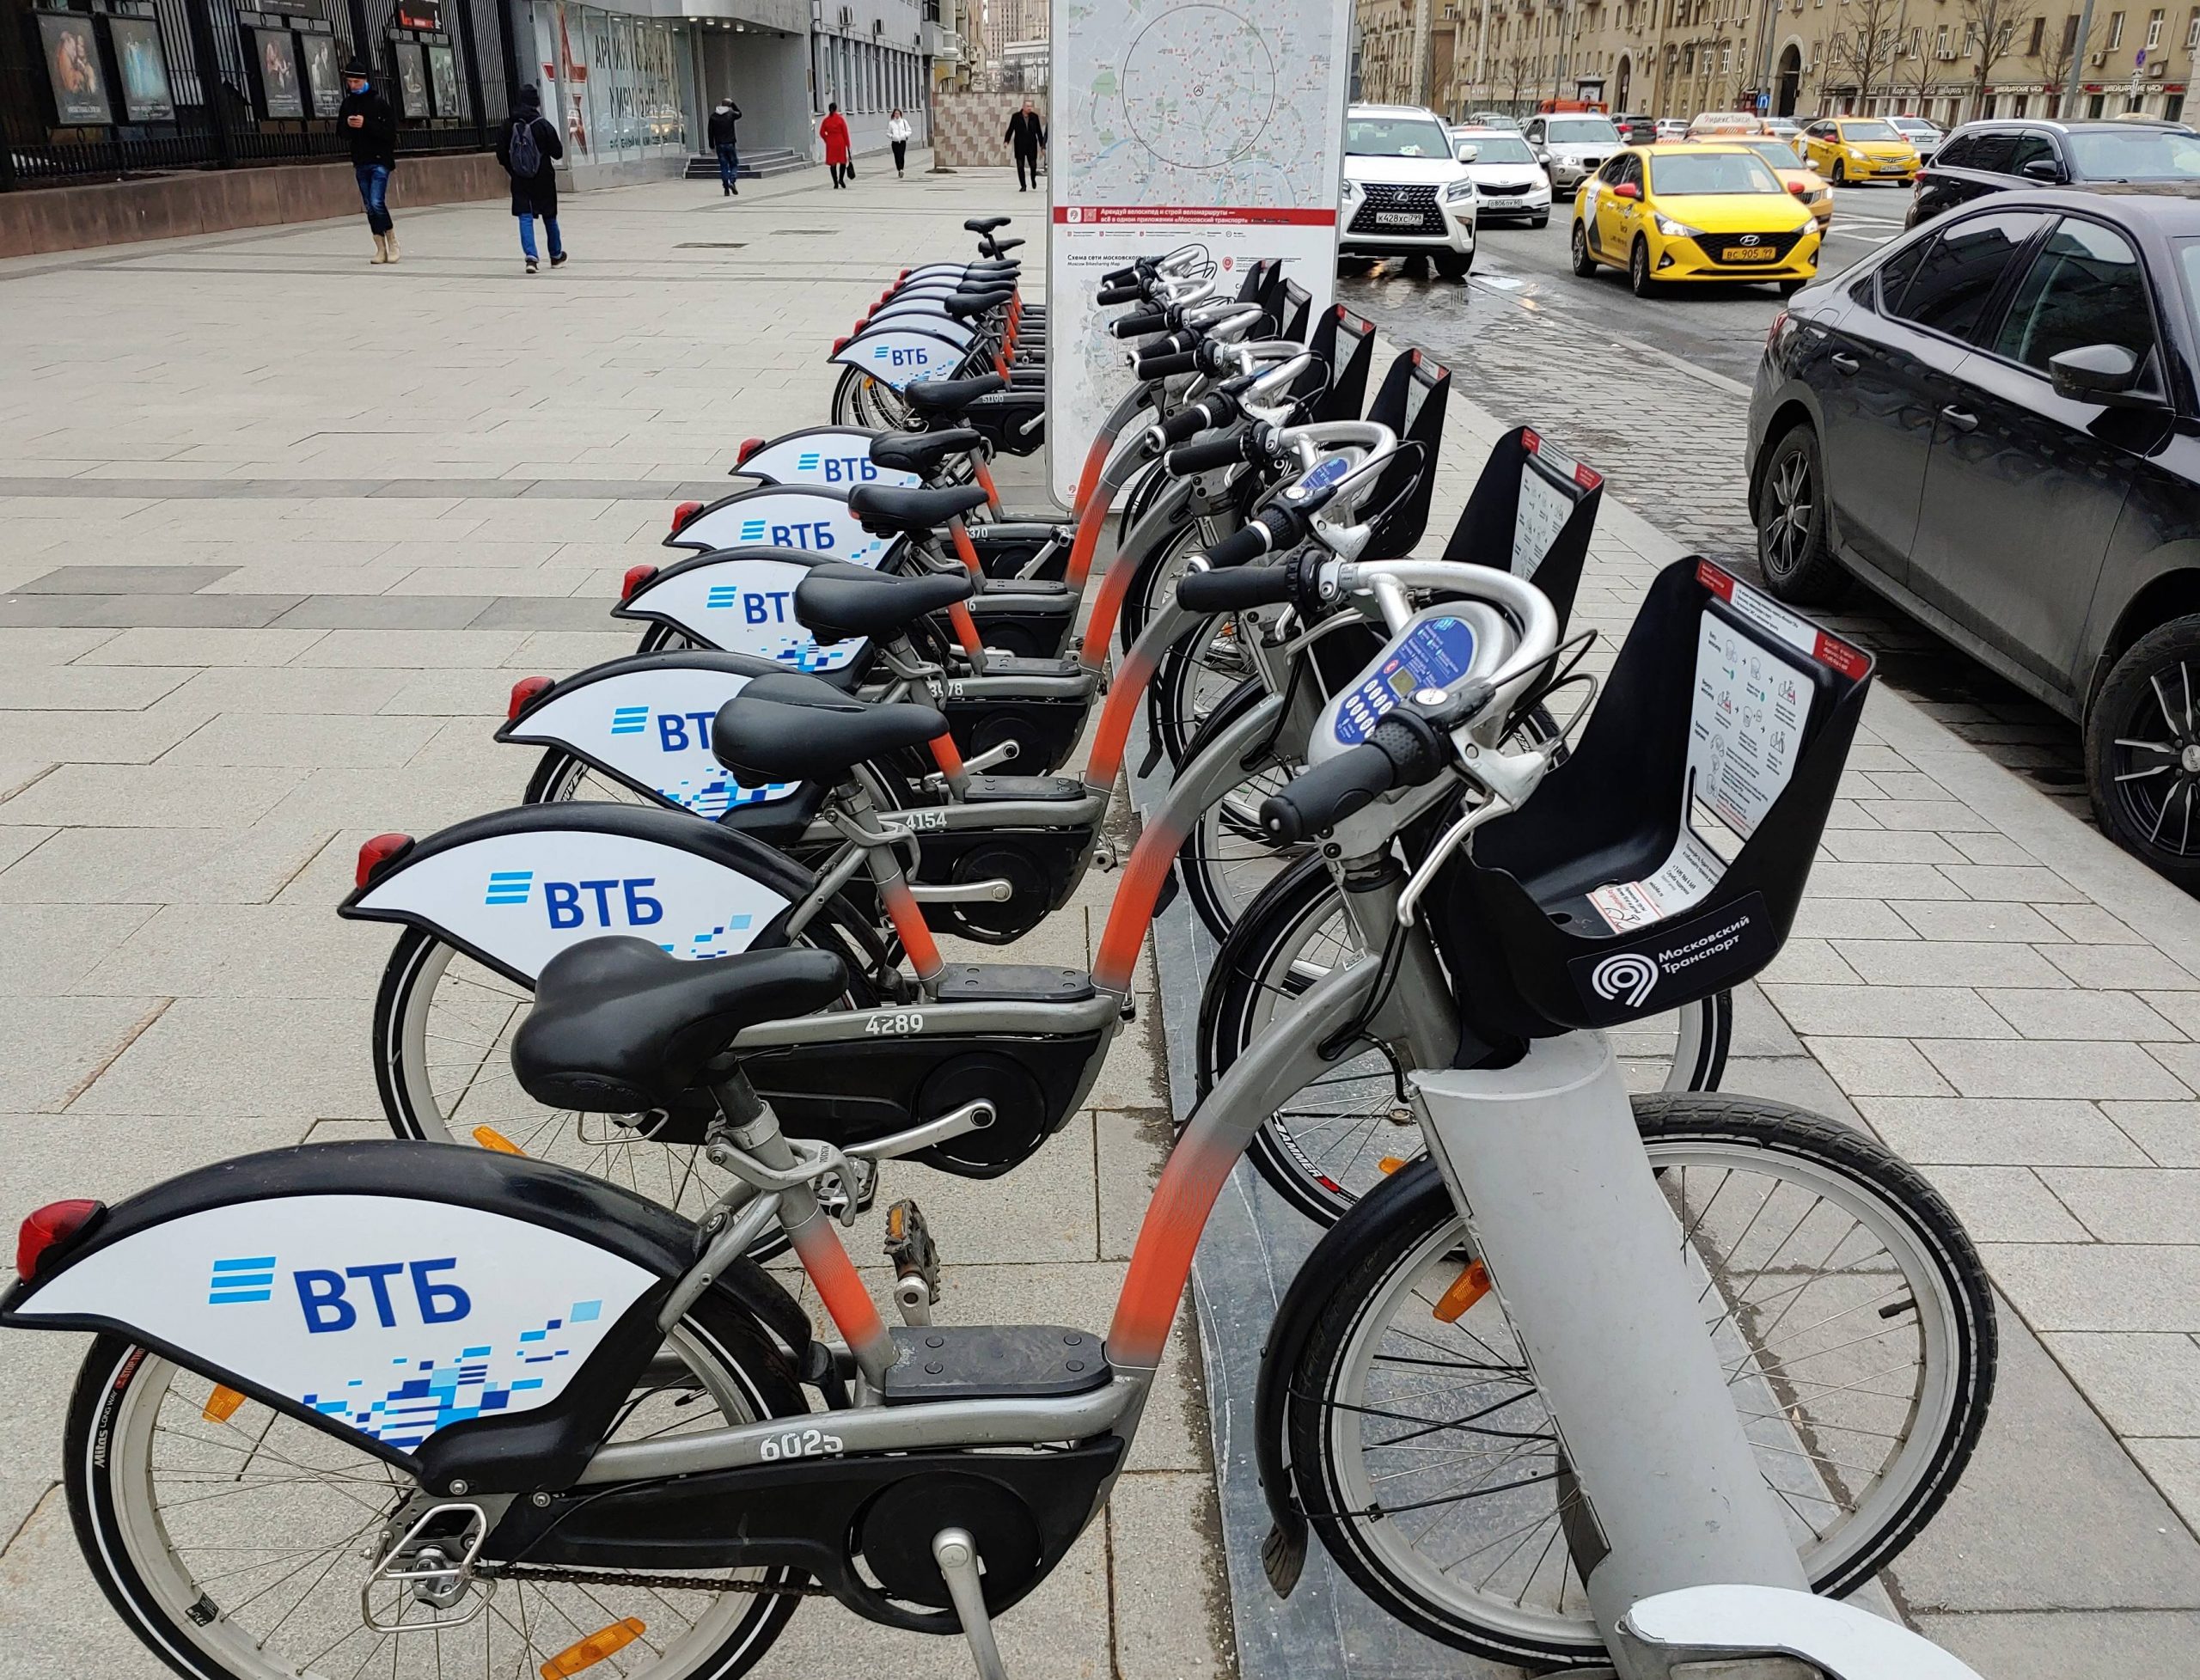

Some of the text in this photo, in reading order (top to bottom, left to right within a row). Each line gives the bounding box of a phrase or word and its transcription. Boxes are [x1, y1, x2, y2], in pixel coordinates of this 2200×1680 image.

[1742, 249, 1759, 259] 905
[891, 348, 928, 366] ВТБ
[824, 457, 878, 483] ВТБ
[772, 522, 835, 550] ВТБ
[965, 527, 988, 539] 370
[742, 591, 797, 625] ВТ
[657, 711, 716, 753] ВТ
[906, 811, 947, 830] 4154
[544, 877, 663, 929] ВТБ
[1658, 915, 1751, 963] Московский
[1662, 934, 1740, 974] Транспорт
[865, 1013, 924, 1035] 4289
[292, 1257, 472, 1334] ВТБ
[101, 1407, 112, 1428] LONG
[107, 1390, 119, 1408] WAY
[761, 1429, 843, 1461] 6025
